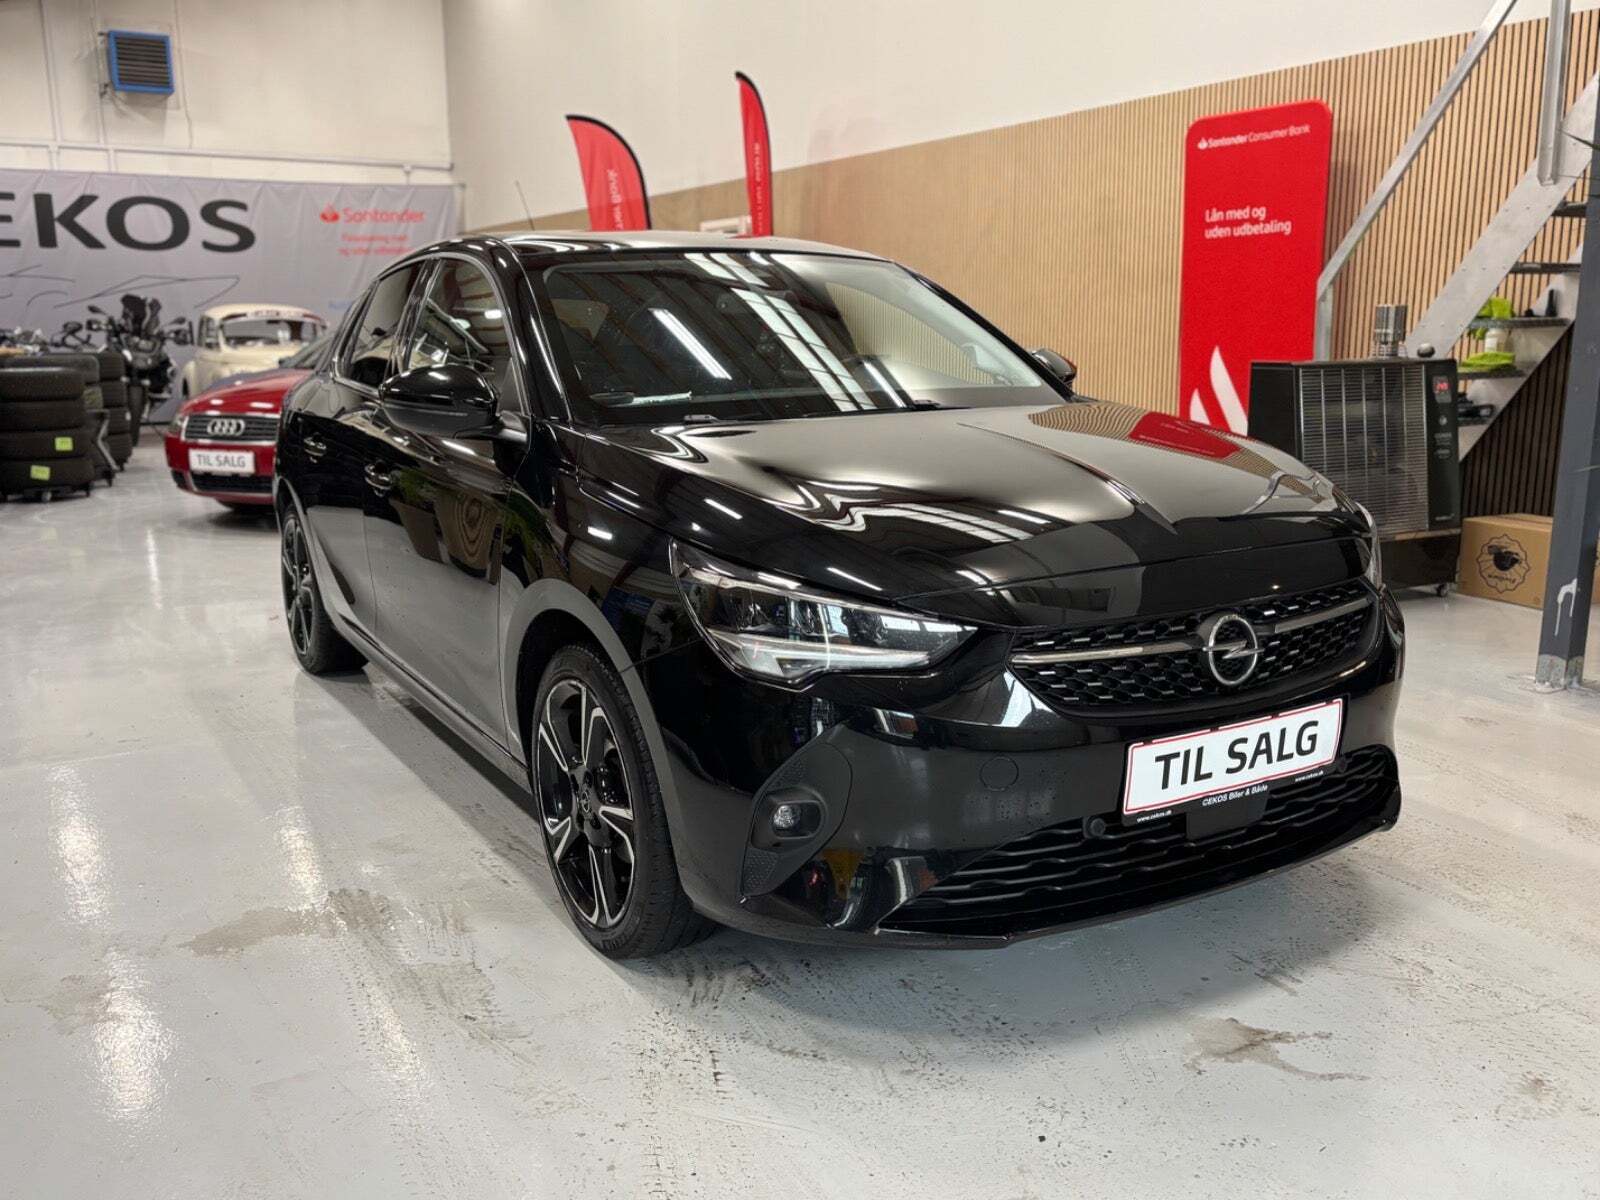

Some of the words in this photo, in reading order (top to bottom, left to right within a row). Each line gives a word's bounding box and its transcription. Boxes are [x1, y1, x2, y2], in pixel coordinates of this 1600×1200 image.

[1208, 134, 1247, 148] Santander
[1248, 128, 1288, 142] Consumer
[1289, 125, 1310, 136] Bank
[343, 207, 425, 224] Santander
[1205, 207, 1224, 223] Lån
[1226, 205, 1250, 221] med
[1251, 206, 1266, 221] og
[1204, 225, 1231, 239] uden
[1232, 219, 1292, 236] udbetaling
[197, 454, 212, 466] TIL
[215, 455, 246, 468] SALG
[1154, 746, 1213, 790] TIL
[1225, 720, 1319, 775] SALG
[1202, 793, 1228, 806] CEKOS
